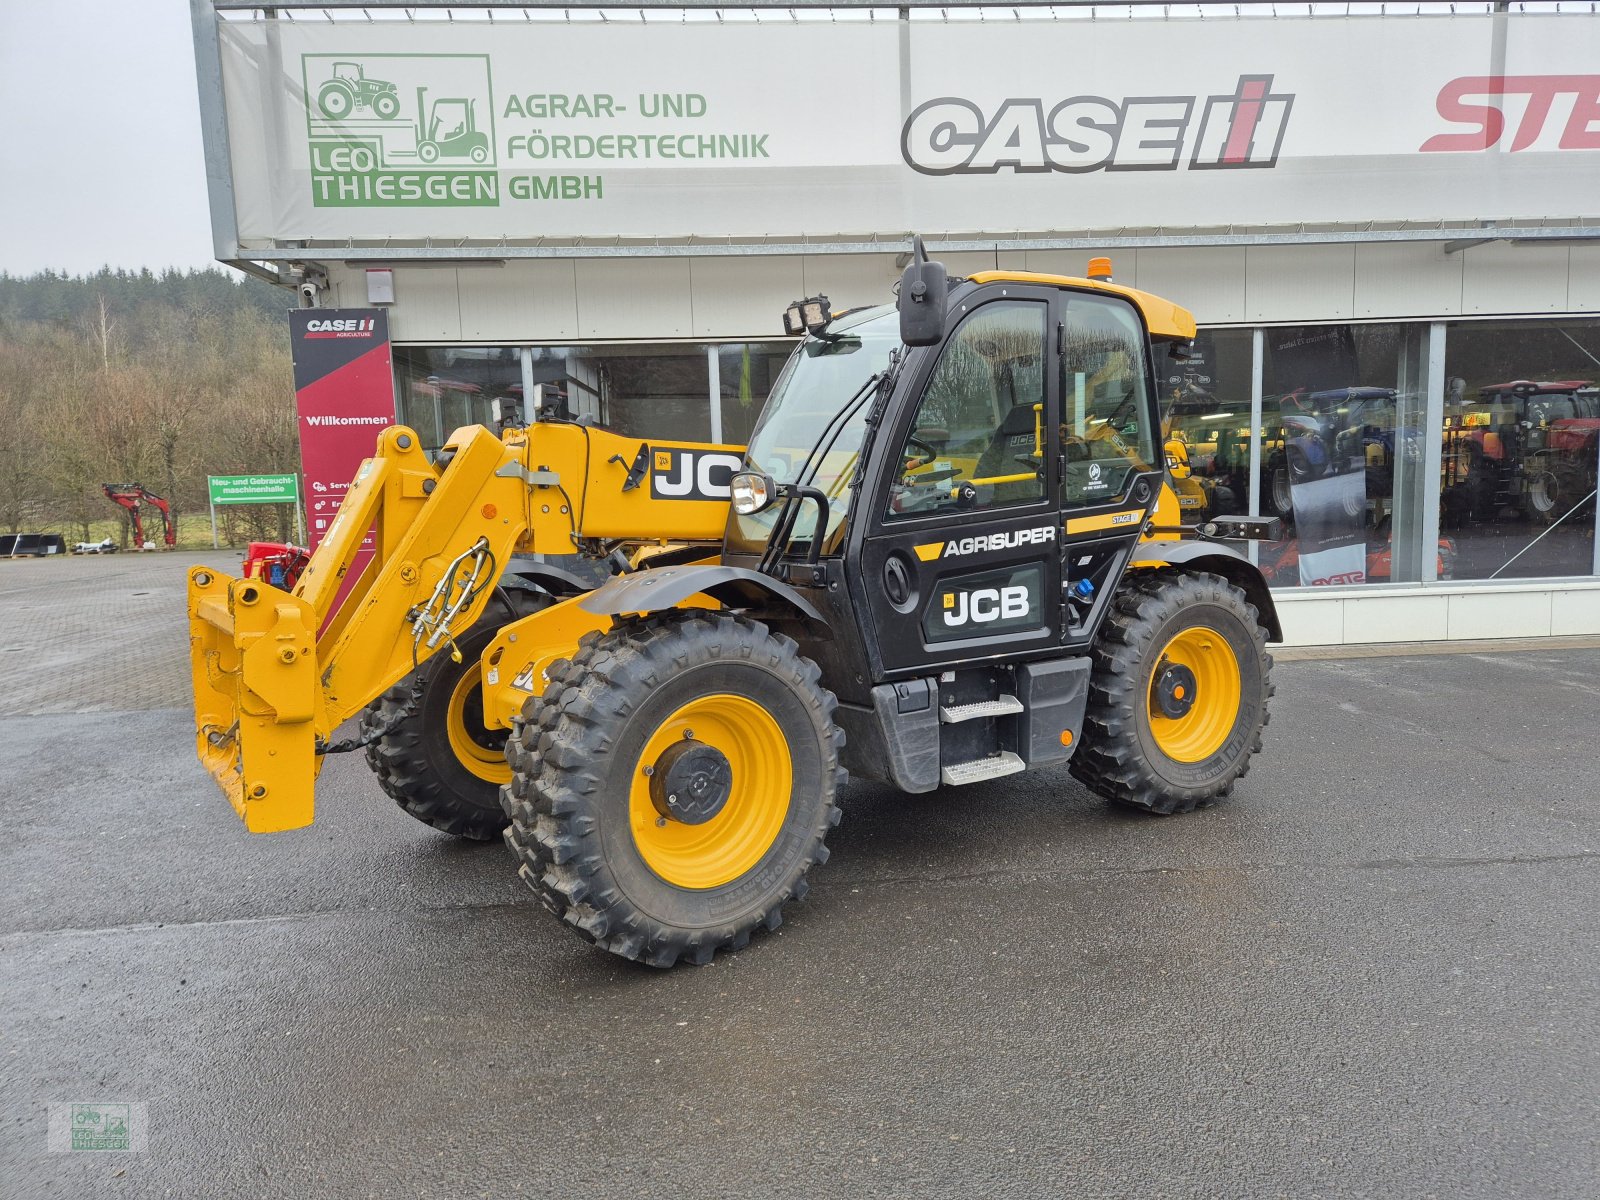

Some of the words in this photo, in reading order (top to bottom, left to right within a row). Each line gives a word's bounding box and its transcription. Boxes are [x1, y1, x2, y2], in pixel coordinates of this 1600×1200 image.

[503, 94, 626, 118] AGRAR-
[639, 93, 707, 117] UND
[507, 129, 770, 159] FÖRDERTECHNIK
[901, 95, 1196, 176] CASE
[313, 147, 374, 172] LEO
[313, 176, 497, 200] THIESGEN
[509, 175, 604, 200] GMBH
[307, 320, 357, 332] CASE
[306, 416, 388, 426] Willkommen
[212, 478, 231, 486] Neu-
[249, 476, 294, 485] Gebraucht-
[654, 452, 742, 497] JC
[223, 485, 284, 494] maschinenhalle
[1112, 514, 1131, 524] STAGE
[943, 526, 1055, 558] AGRISUPER
[943, 586, 1030, 627] JCB
